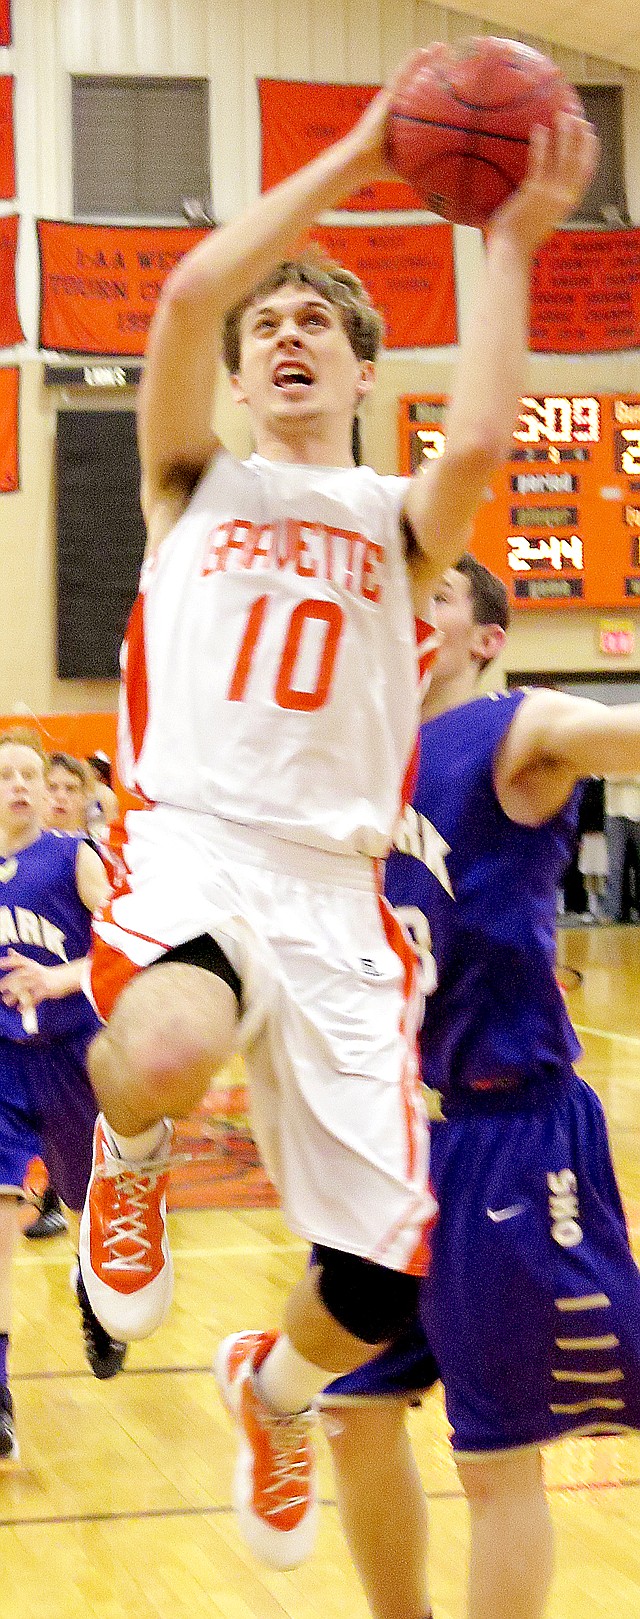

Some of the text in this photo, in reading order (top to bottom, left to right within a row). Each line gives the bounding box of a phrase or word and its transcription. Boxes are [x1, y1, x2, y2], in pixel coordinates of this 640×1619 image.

[200, 518, 384, 604] GRAVETTE
[227, 593, 345, 713] 10
[546, 1168, 584, 1248] OHS
